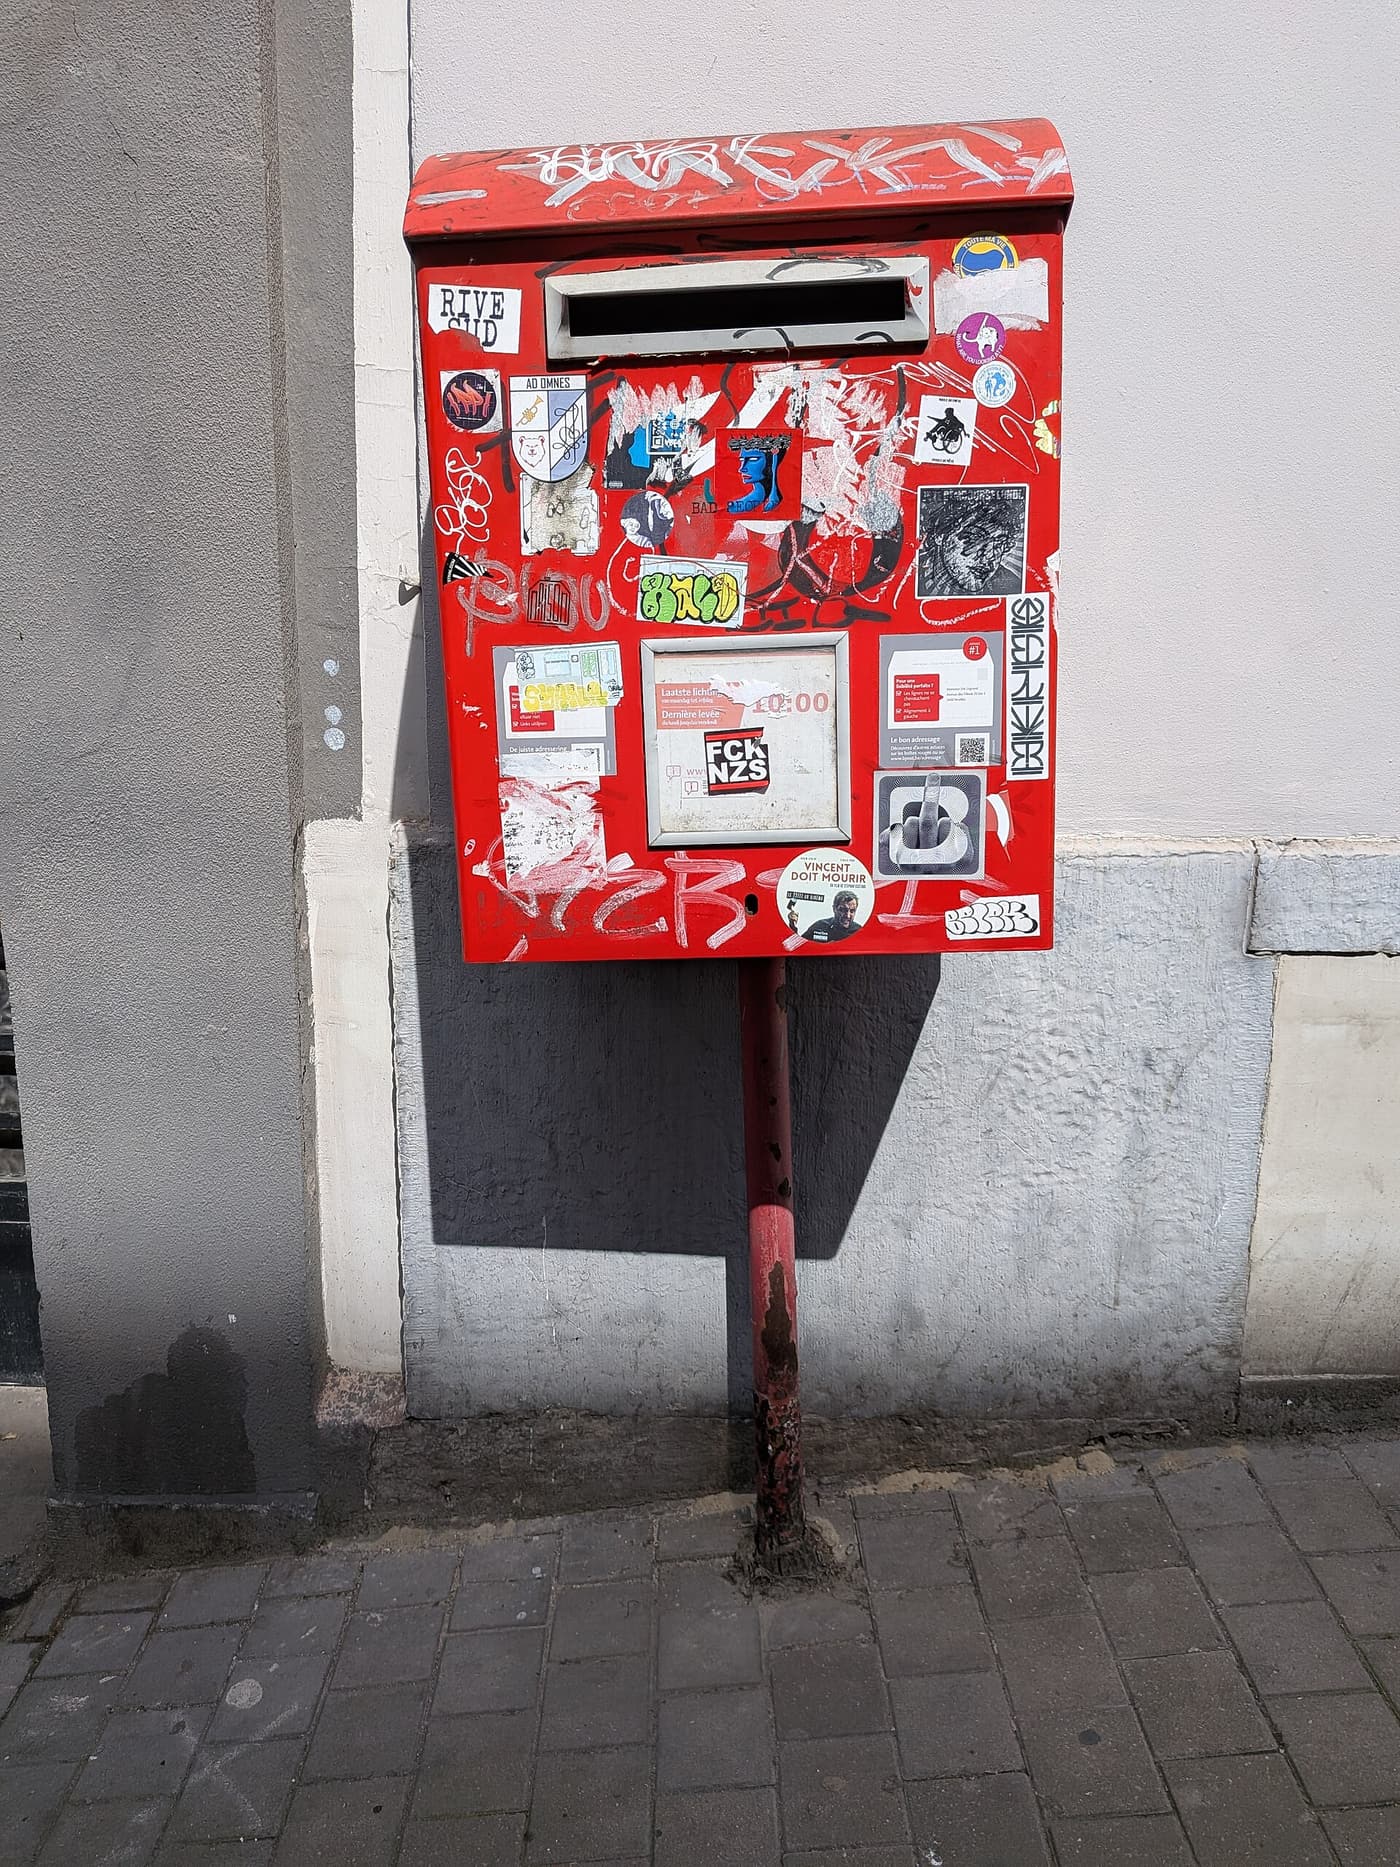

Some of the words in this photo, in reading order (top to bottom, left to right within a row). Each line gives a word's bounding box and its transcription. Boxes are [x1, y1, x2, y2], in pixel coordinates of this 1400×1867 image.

[997, 238, 1007, 249] VIE
[440, 288, 505, 320] RIVE
[526, 378, 538, 389] AD
[540, 377, 571, 389] OMNES
[692, 501, 717, 514] BAD
[661, 687, 691, 697] Laatste
[752, 692, 830, 714] 10:00
[662, 709, 697, 719] Dernière
[698, 709, 720, 719] levée
[705, 739, 767, 763] FCK
[707, 759, 768, 785] NZS
[804, 861, 851, 873] VINCENT
[791, 871, 819, 882] DOIT
[821, 872, 867, 884] MOURIR
